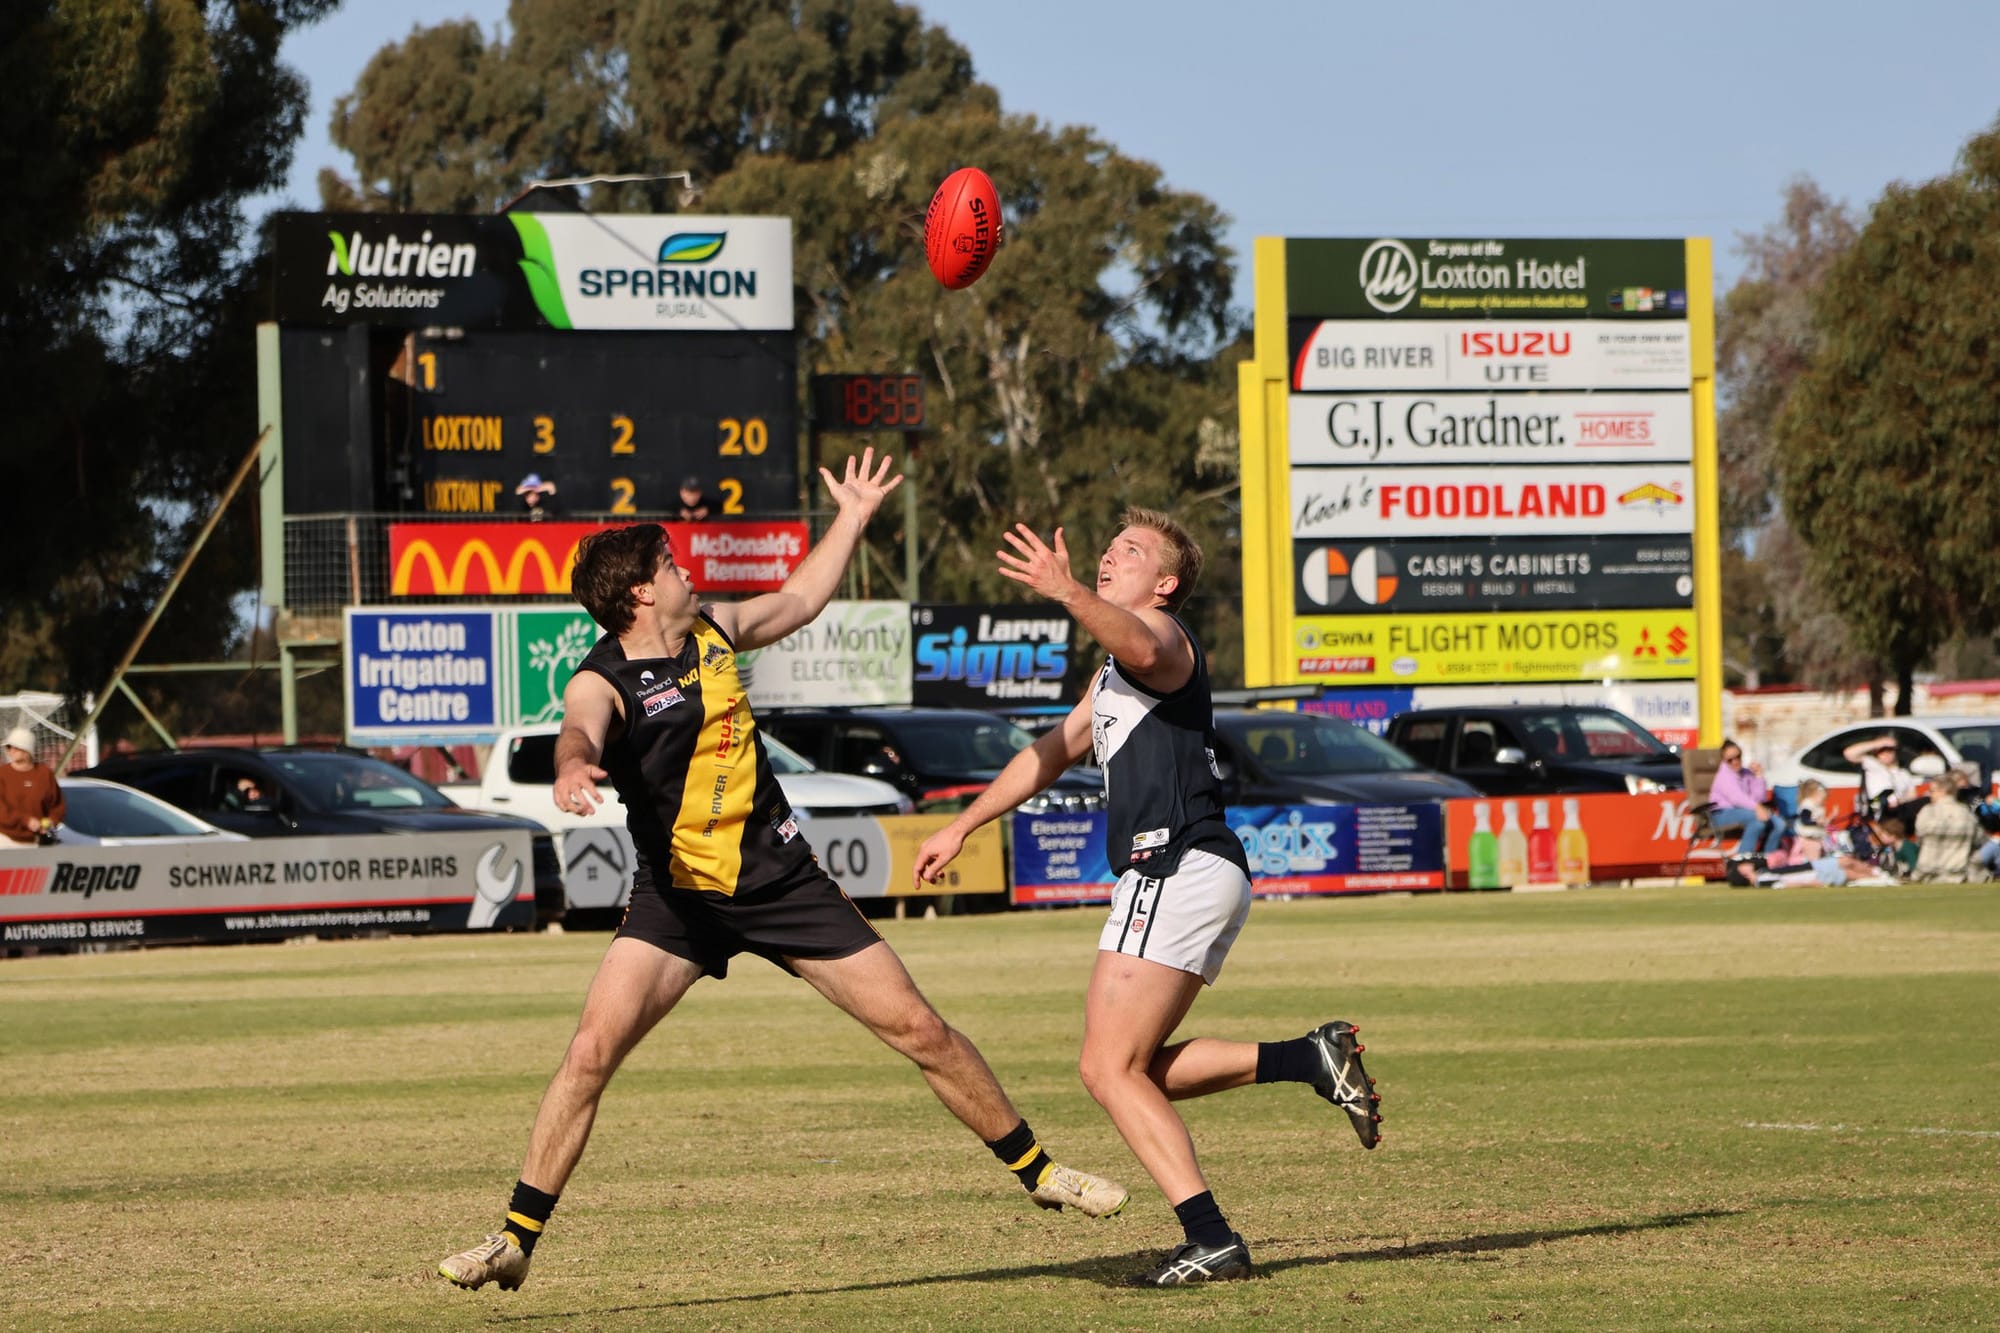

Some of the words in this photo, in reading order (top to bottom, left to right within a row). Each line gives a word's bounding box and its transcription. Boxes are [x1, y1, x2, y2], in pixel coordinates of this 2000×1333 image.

[327, 229, 477, 278] Nutrien
[1428, 240, 1448, 256] See
[579, 269, 757, 297] SPARNON
[1421, 257, 1510, 289] Loxton
[1516, 256, 1586, 289] Hotel
[322, 282, 351, 313] Ag
[352, 281, 440, 308] Solutions
[656, 303, 707, 319] RURAL
[1316, 347, 1355, 369] BIG
[1364, 347, 1434, 368] RIVER
[1462, 333, 1570, 357] ISUZU
[417, 352, 436, 390] 1
[1484, 365, 1549, 382] UTE
[422, 415, 503, 451] LOXTON
[532, 416, 556, 454] 3
[611, 416, 636, 454] 2
[718, 418, 769, 456] 20
[1327, 400, 1394, 460] G.J.
[1405, 400, 1565, 449] Gardner.
[1580, 420, 1651, 440] HOMES
[611, 477, 637, 514] 2
[719, 479, 745, 514] 2
[1379, 483, 1606, 520] FOODLAND
[690, 532, 801, 556] McDonald's
[704, 560, 790, 582] Renmark
[1407, 555, 1484, 578] CASH'S
[1489, 554, 1592, 577] CABINETS
[1421, 583, 1464, 597] DESIGN
[1481, 582, 1516, 596] BUILD
[378, 619, 467, 652] Loxton
[824, 621, 906, 659] Monty
[977, 614, 1070, 643] Larry
[1322, 632, 1374, 647] GWM
[1389, 625, 1488, 653] FLIGHT
[1498, 622, 1619, 650] MOTORS
[791, 658, 897, 682] ELECTRICAL
[914, 626, 1070, 688] Signs
[358, 654, 488, 692] Irrigation
[636, 677, 673, 699] Riverland
[998, 677, 1063, 700] Tinting
[379, 689, 470, 722] Centre
[715, 697, 737, 759] ISUZU
[702, 818, 718, 838] BIG
[711, 774, 728, 815] RIVER
[1031, 819, 1093, 835] Electrical
[1038, 836, 1086, 850] Service
[1238, 810, 1338, 874] ogix
[826, 838, 868, 878] CO
[1048, 850, 1077, 865] and
[50, 862, 141, 898] Repco
[169, 864, 276, 888] SCHWARZ
[284, 859, 361, 882] MOTOR
[368, 856, 458, 880] REPAIRS
[1045, 865, 1081, 879] Sales
[5, 924, 87, 942] AUTHORISED
[90, 919, 144, 938] SERVICE
[224, 908, 431, 931] www.schwarzmotorrepairs.com.au
